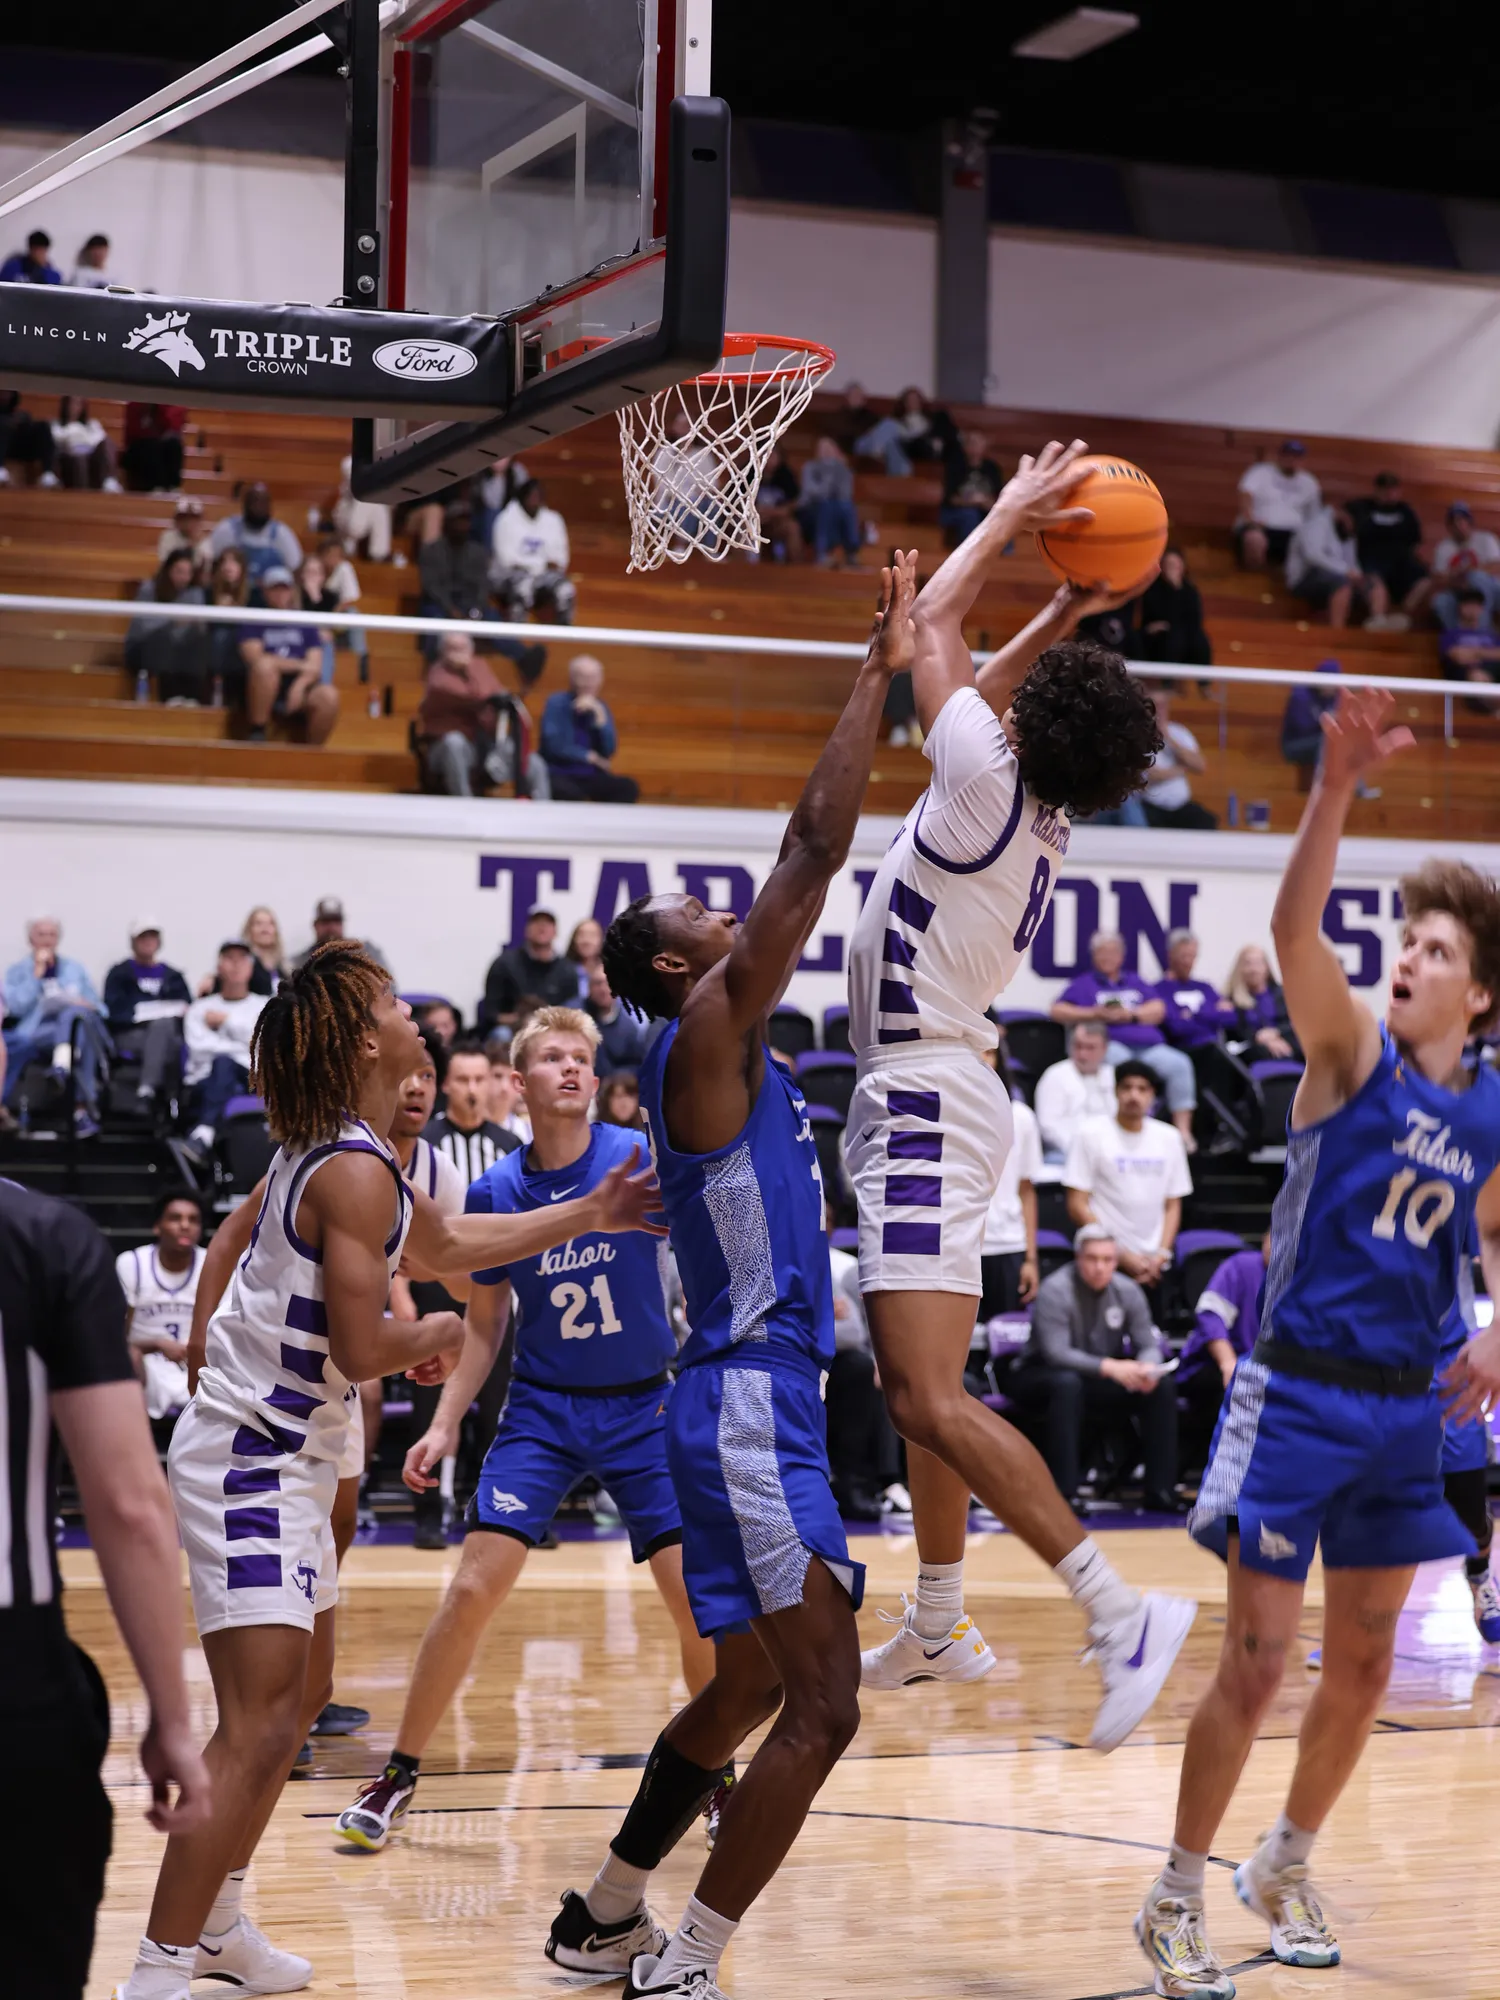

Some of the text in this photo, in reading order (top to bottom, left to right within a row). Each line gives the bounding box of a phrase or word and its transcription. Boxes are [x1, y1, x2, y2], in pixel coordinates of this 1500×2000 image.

[8, 323, 108, 342] LINCOLN
[210, 328, 353, 367] TRIPLE
[246, 359, 308, 375] CROWN
[394, 345, 456, 373] Ford
[1013, 854, 1051, 953] 8
[1392, 1108, 1475, 1184] Tabor
[1371, 1164, 1456, 1250] 10
[550, 1274, 623, 1340] 21
